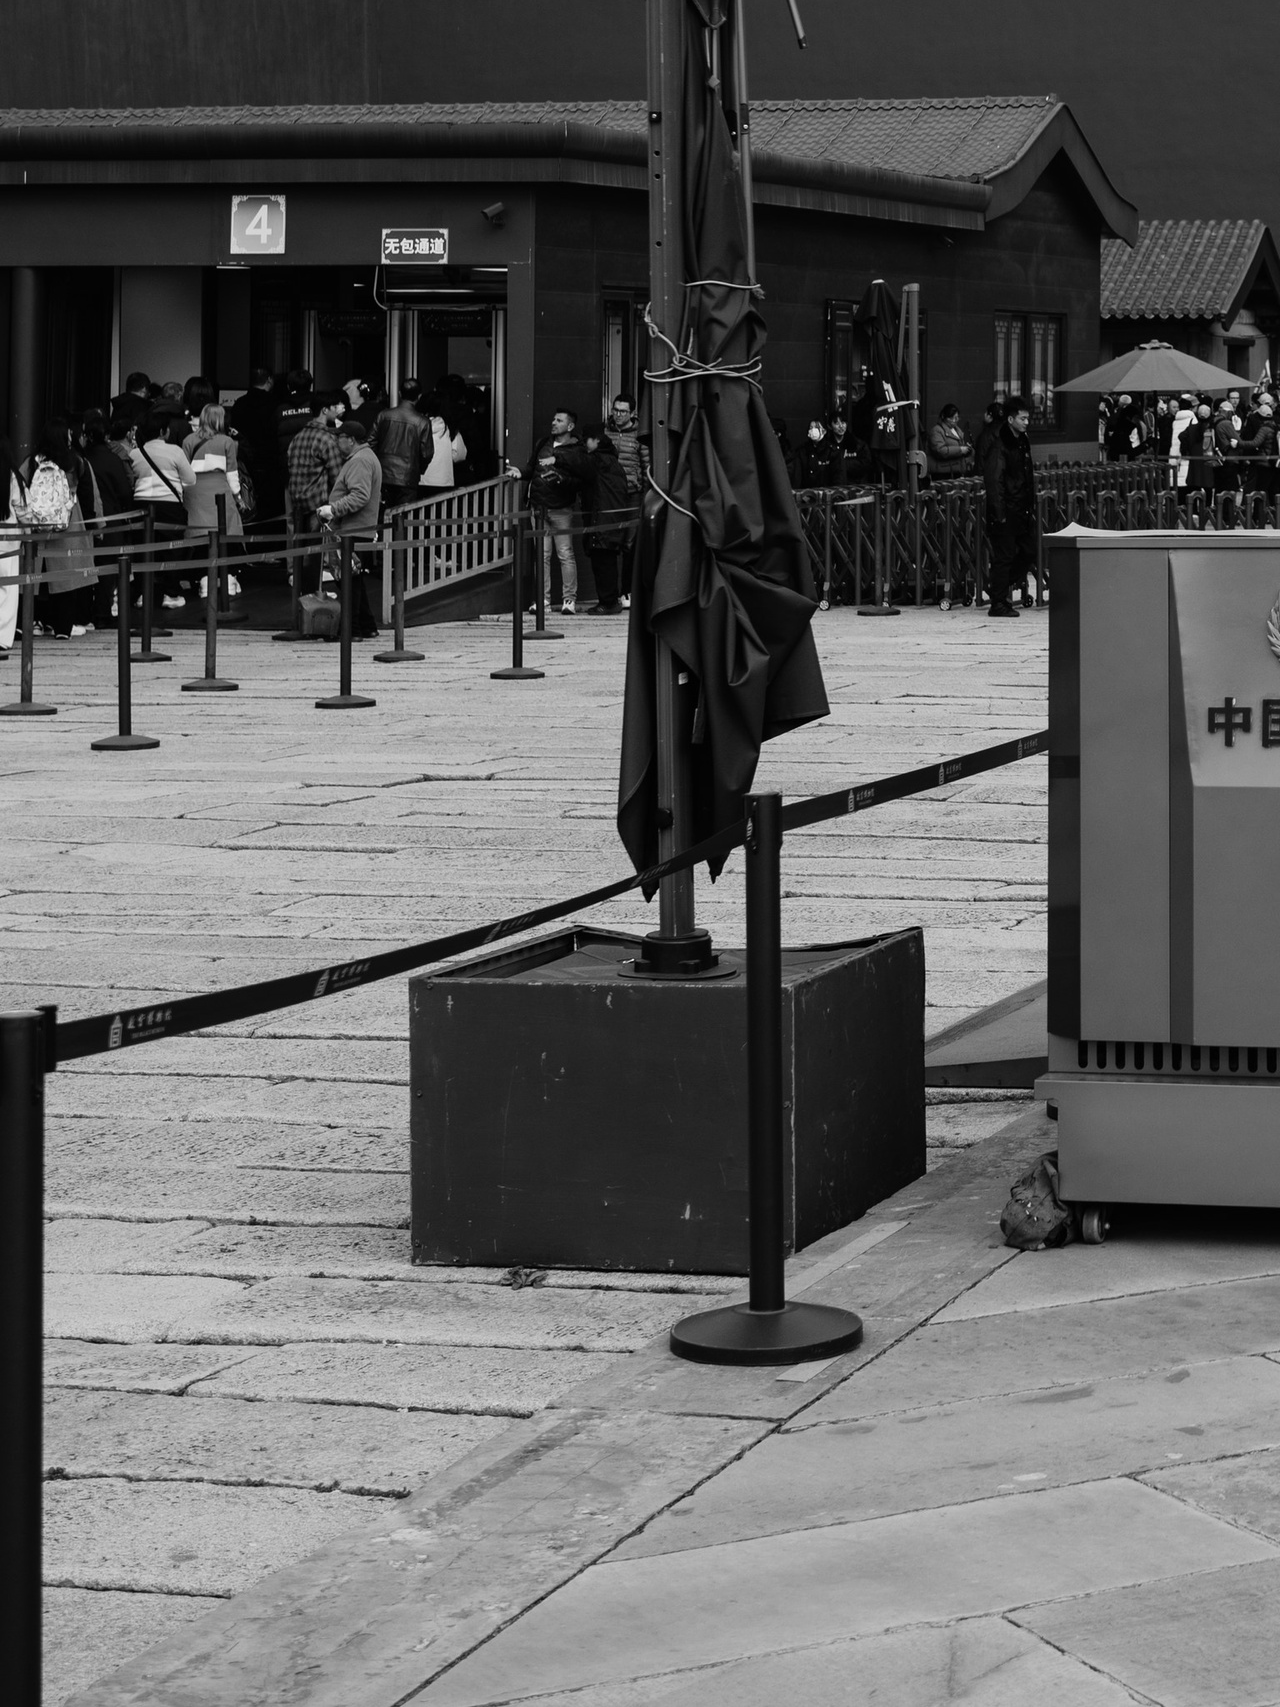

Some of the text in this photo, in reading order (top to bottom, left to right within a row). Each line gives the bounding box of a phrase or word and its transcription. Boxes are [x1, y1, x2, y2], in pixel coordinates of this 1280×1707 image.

[245, 204, 272, 243] 4
[384, 237, 445, 255] 无包通道
[282, 407, 311, 416] KELME
